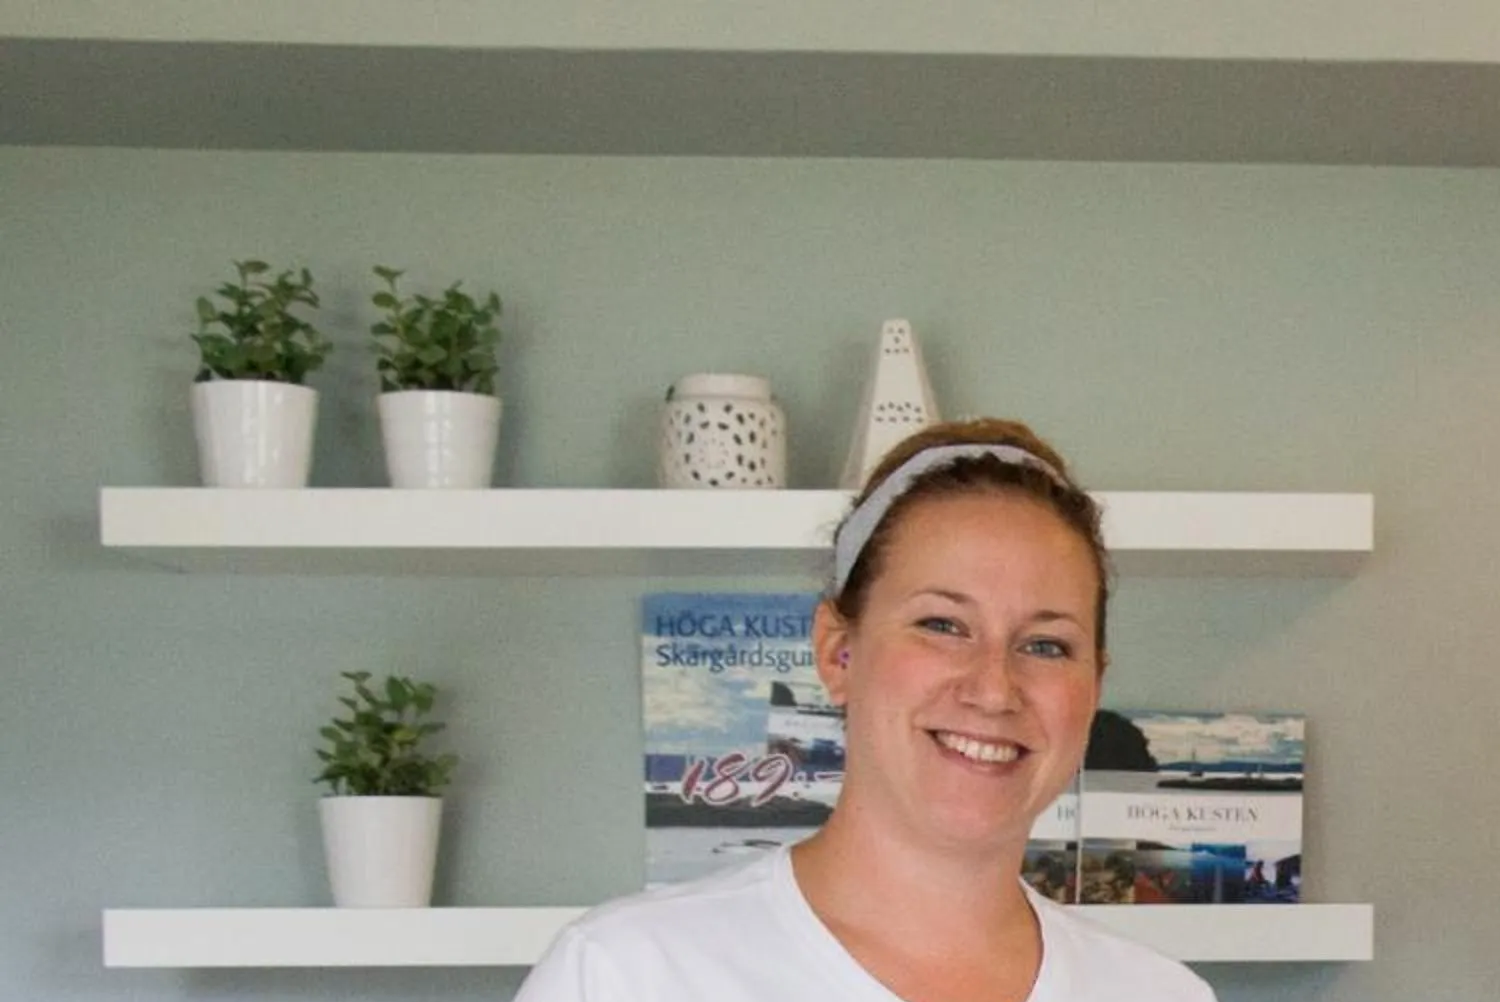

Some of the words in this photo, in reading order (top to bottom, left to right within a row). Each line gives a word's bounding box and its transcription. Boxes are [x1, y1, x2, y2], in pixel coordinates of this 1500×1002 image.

[655, 609, 736, 638] HÖGA
[744, 614, 813, 639] KUST
[655, 641, 814, 674] Skärgårdsgui
[1186, 806, 1259, 822] KUSTEN
